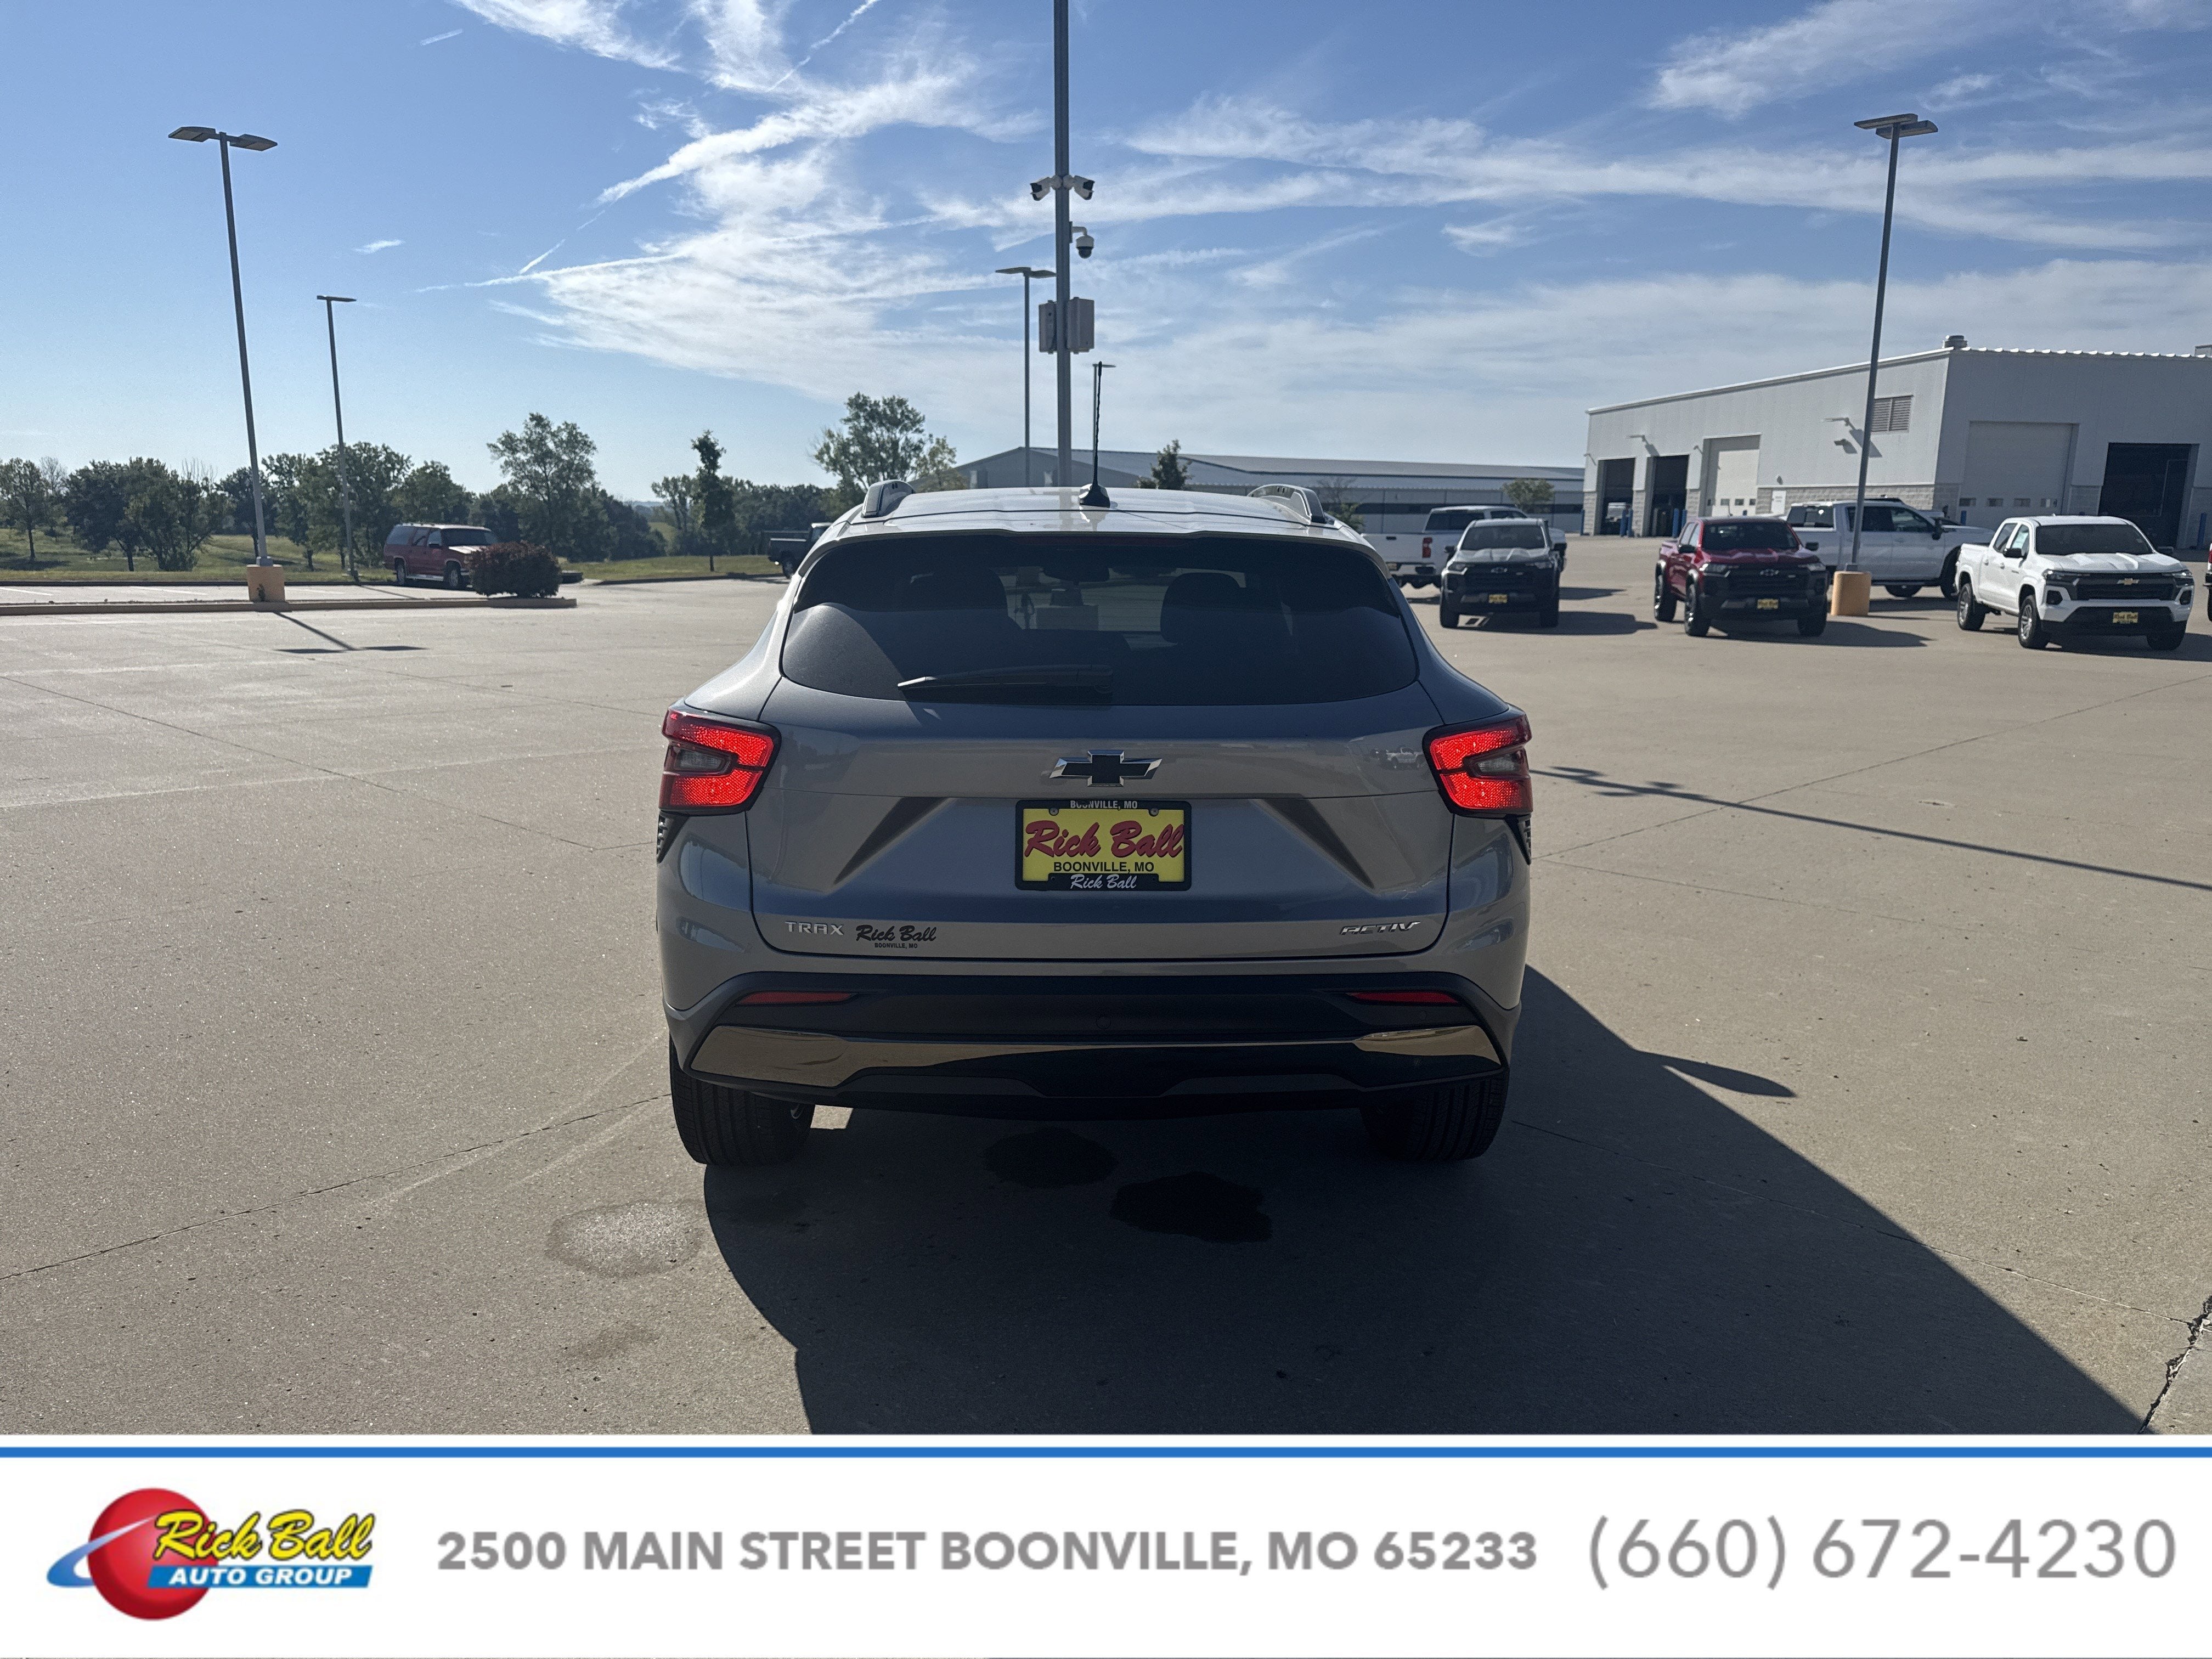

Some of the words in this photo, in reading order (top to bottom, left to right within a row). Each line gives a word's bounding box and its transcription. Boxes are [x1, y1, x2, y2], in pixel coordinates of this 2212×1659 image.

[1124, 800, 1138, 809] MO
[1024, 820, 1101, 857] Rick
[1110, 820, 1184, 857] Ball
[1053, 861, 1131, 873] BOONVILLE,
[1135, 862, 1154, 872] MO
[1070, 873, 1103, 889] Rick
[1106, 874, 1137, 889] Ball
[785, 921, 844, 935] TRAX
[856, 924, 896, 941] Rick
[899, 925, 936, 941] Ball
[1339, 921, 1421, 935] ACTIV
